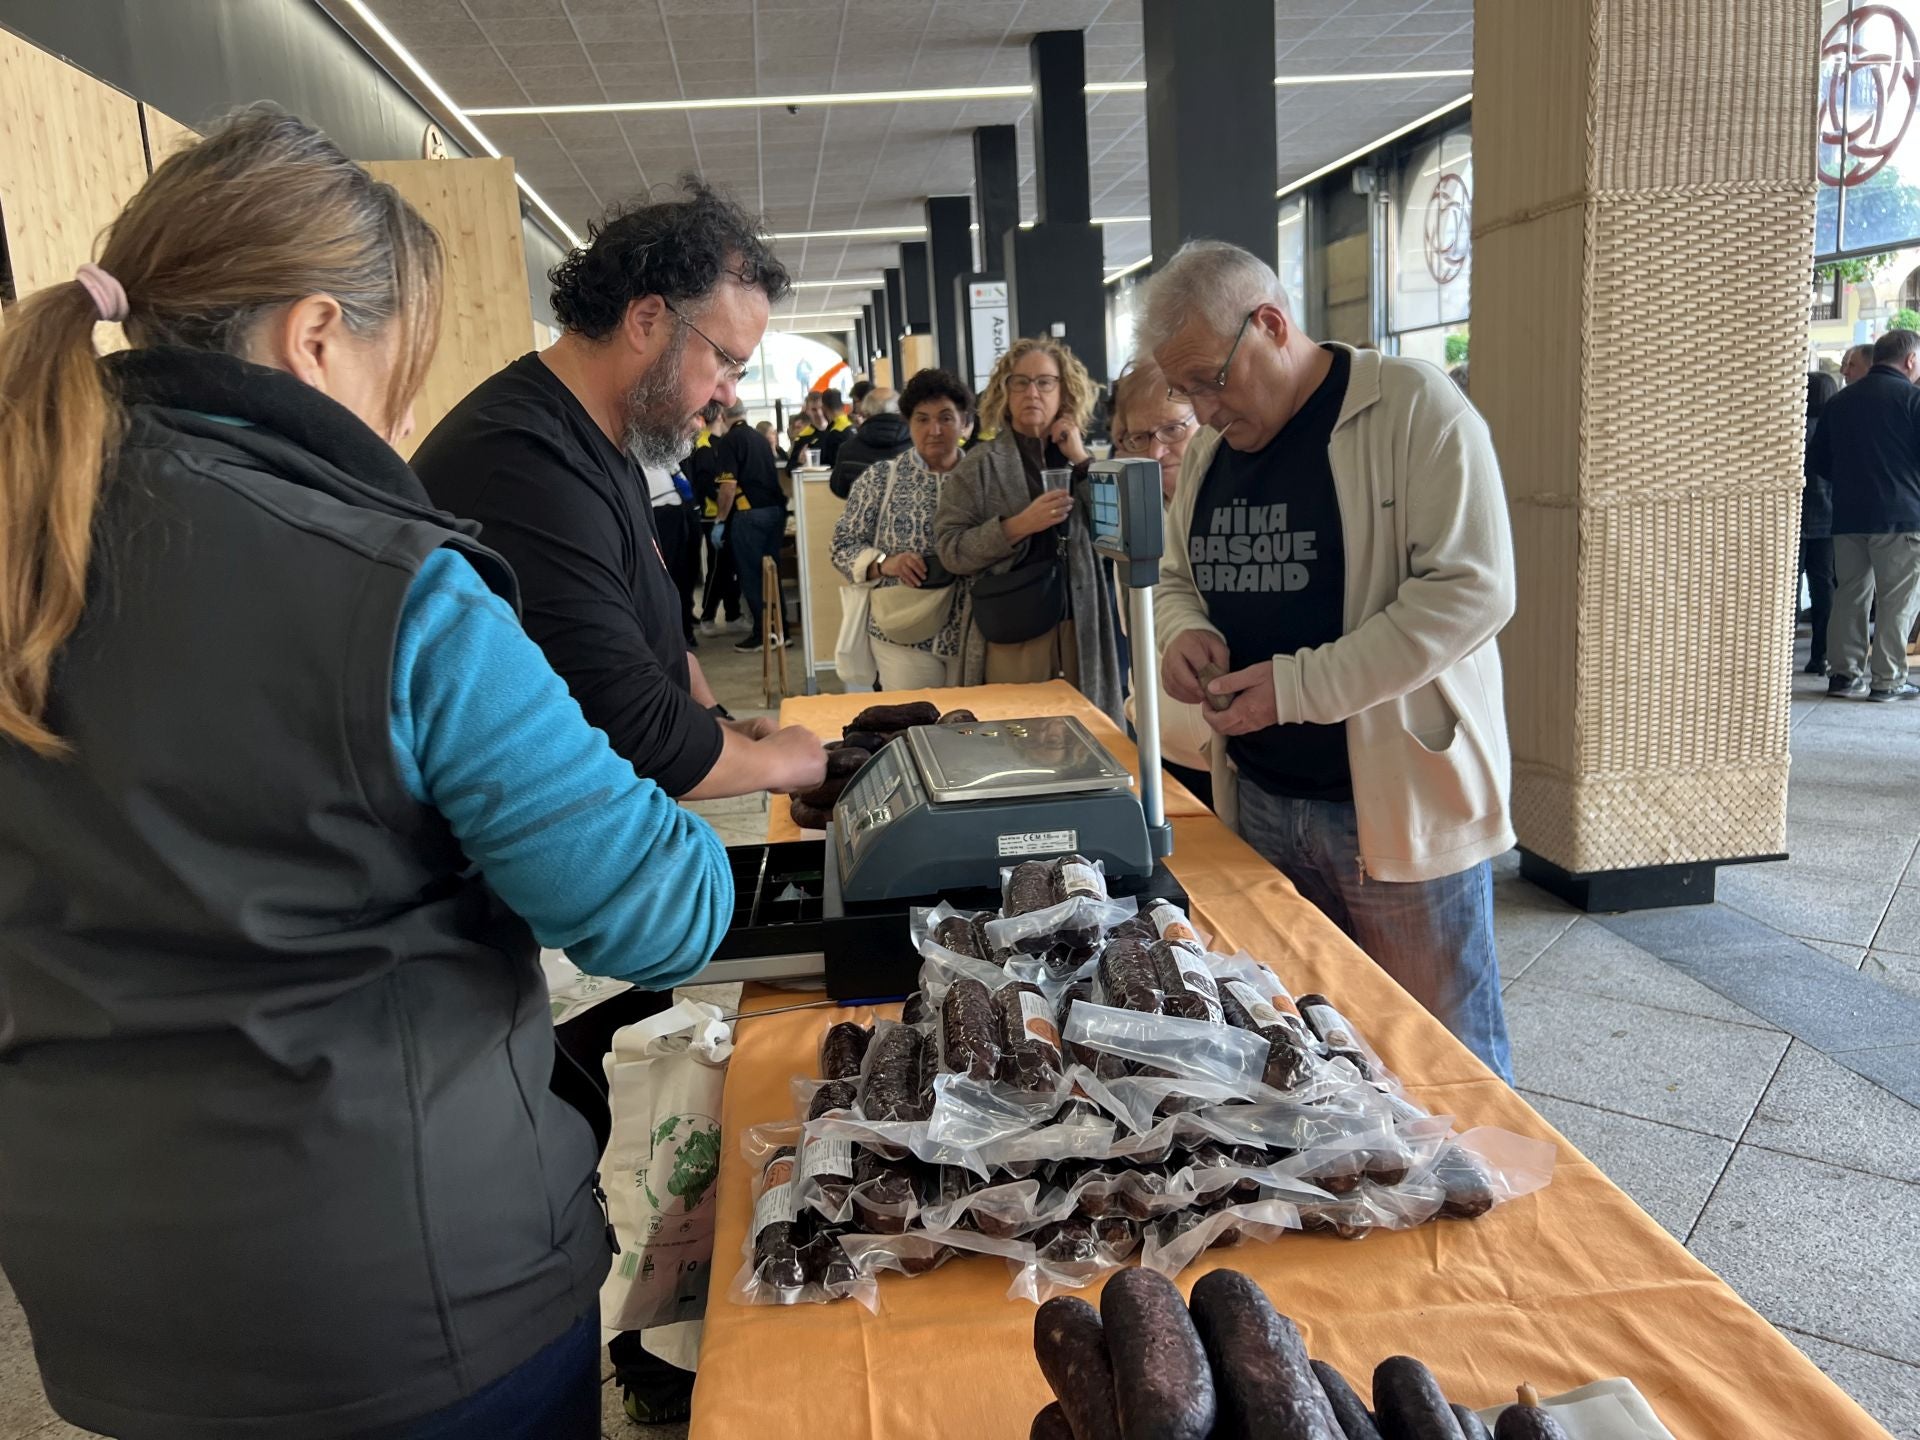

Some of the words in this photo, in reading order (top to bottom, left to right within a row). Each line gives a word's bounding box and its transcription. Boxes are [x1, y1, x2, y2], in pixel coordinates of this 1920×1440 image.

[1210, 498, 1287, 534] HÏKA
[1190, 531, 1317, 564] BASQUE
[1196, 563, 1309, 592] BRAND
